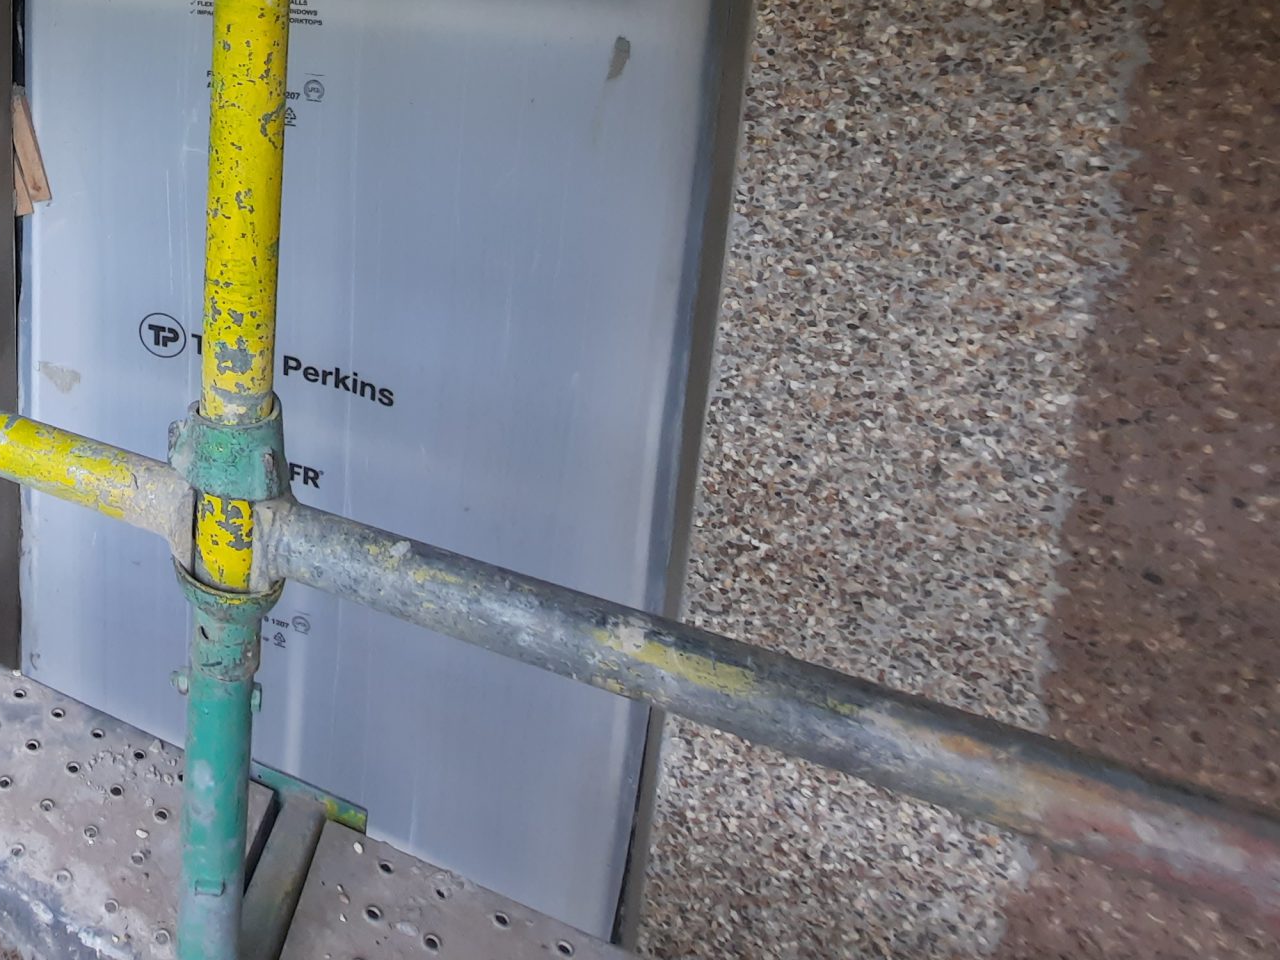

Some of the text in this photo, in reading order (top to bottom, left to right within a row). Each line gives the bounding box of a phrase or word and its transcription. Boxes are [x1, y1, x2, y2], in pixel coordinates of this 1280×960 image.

[289, 18, 323, 26] ORKTOPS
[285, 91, 300, 100] 207
[148, 323, 180, 347] TP
[283, 355, 395, 408] Perkins
